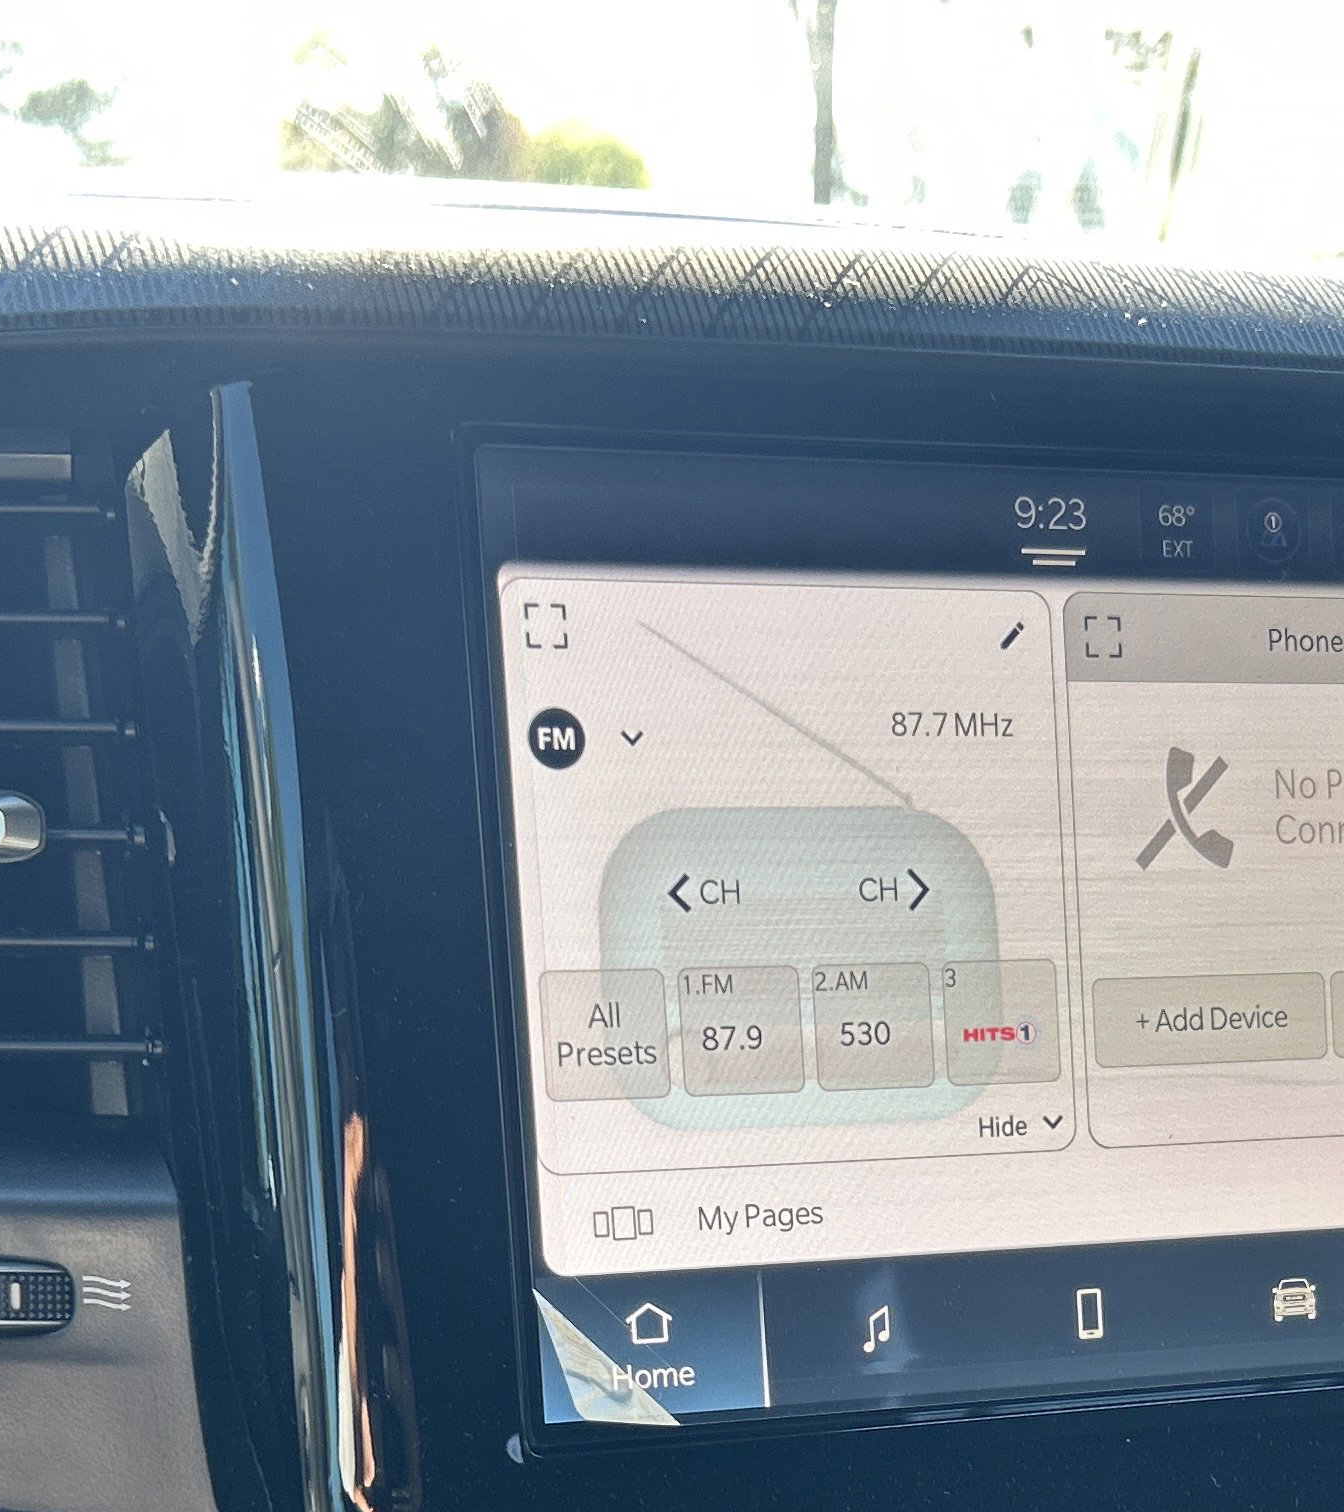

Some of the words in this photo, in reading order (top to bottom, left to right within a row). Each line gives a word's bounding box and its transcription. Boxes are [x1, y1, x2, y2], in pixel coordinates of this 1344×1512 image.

[1014, 497, 1087, 531] 9:23
[1162, 540, 1194, 559] EXT
[1267, 628, 1344, 654] Phone
[890, 711, 948, 738] 87.7
[954, 713, 1014, 739] MHz
[537, 726, 576, 752] FM
[1274, 769, 1317, 800] No
[699, 879, 741, 905] CH
[858, 877, 899, 903] CH
[682, 974, 734, 996] 1.FM
[814, 970, 869, 993] 2.AM
[944, 968, 957, 989] 3
[588, 1002, 621, 1029] All
[1155, 1006, 1204, 1034] Add
[1210, 1005, 1289, 1031] Device
[701, 1025, 763, 1052] 87.9
[839, 1021, 891, 1047] 530
[557, 1040, 658, 1067] Presets
[978, 1115, 1028, 1139] Hide
[698, 1205, 739, 1237] My
[745, 1202, 825, 1232] Pages
[612, 1364, 696, 1390] Home
